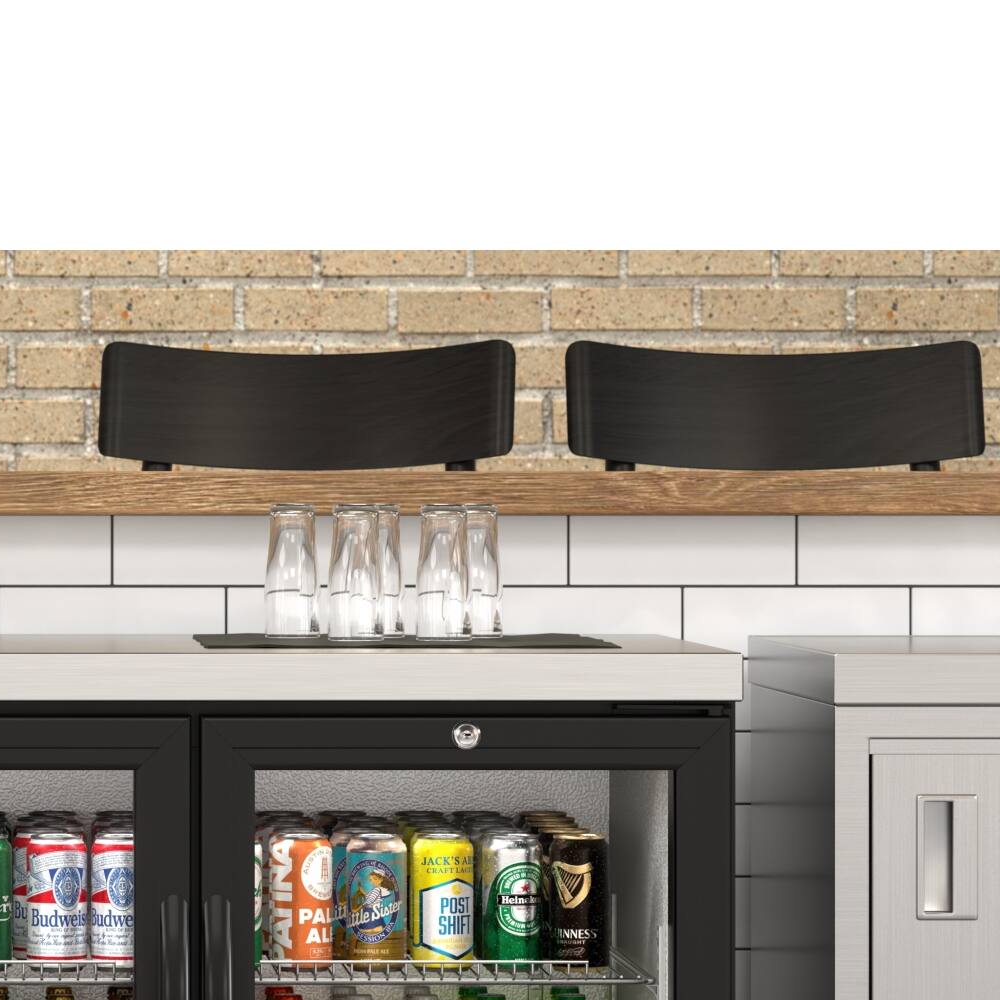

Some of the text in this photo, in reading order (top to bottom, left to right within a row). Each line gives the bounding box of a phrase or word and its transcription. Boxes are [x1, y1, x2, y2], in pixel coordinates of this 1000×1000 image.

[421, 856, 460, 866] JACK'S
[371, 900, 402, 921] Sister
[440, 896, 470, 914] POST
[31, 908, 86, 927] Budweis
[91, 909, 134, 927] Budwe
[298, 908, 333, 924] PAL
[439, 915, 470, 935] SHIFT
